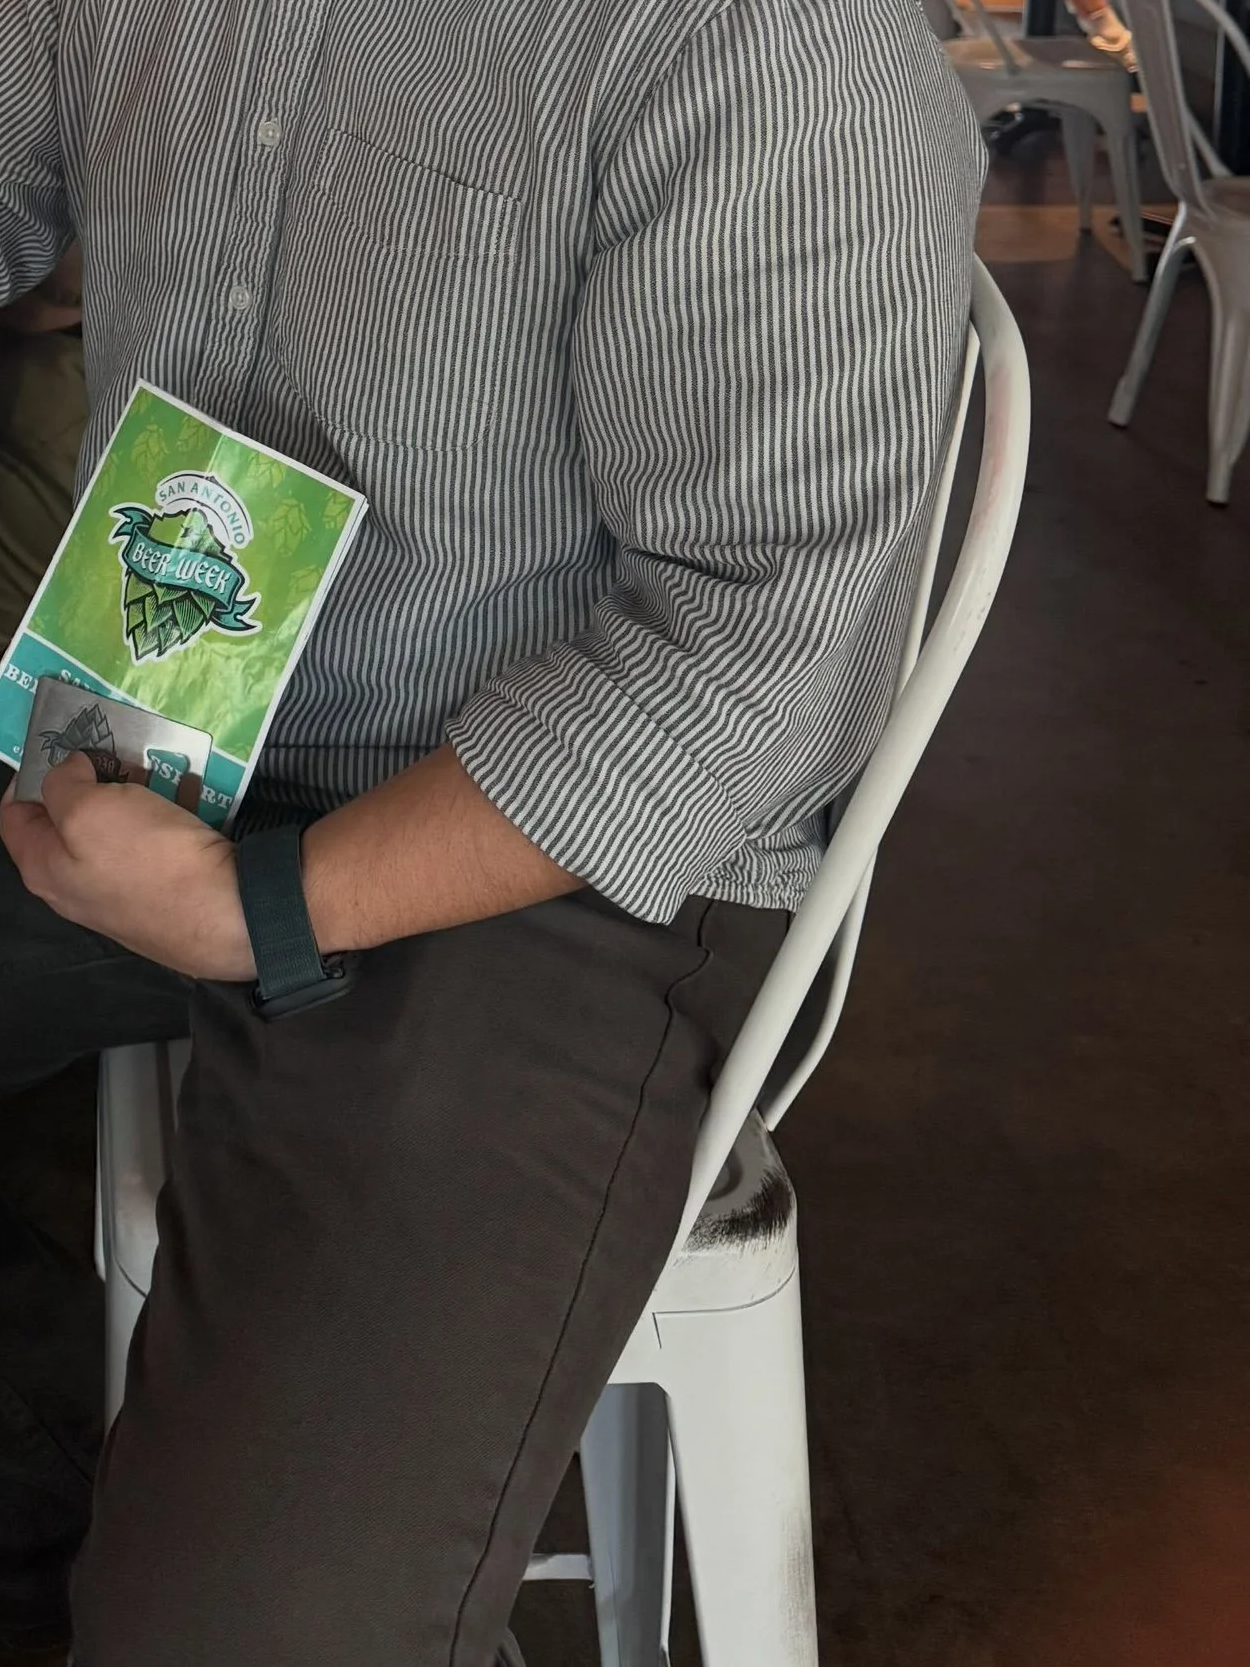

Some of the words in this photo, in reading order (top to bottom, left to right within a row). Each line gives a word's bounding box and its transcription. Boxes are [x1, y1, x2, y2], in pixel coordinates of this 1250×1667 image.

[159, 481, 185, 502] SAN
[190, 482, 246, 545] ANTONIO
[132, 541, 172, 577] BEER
[175, 557, 232, 595] WEEK
